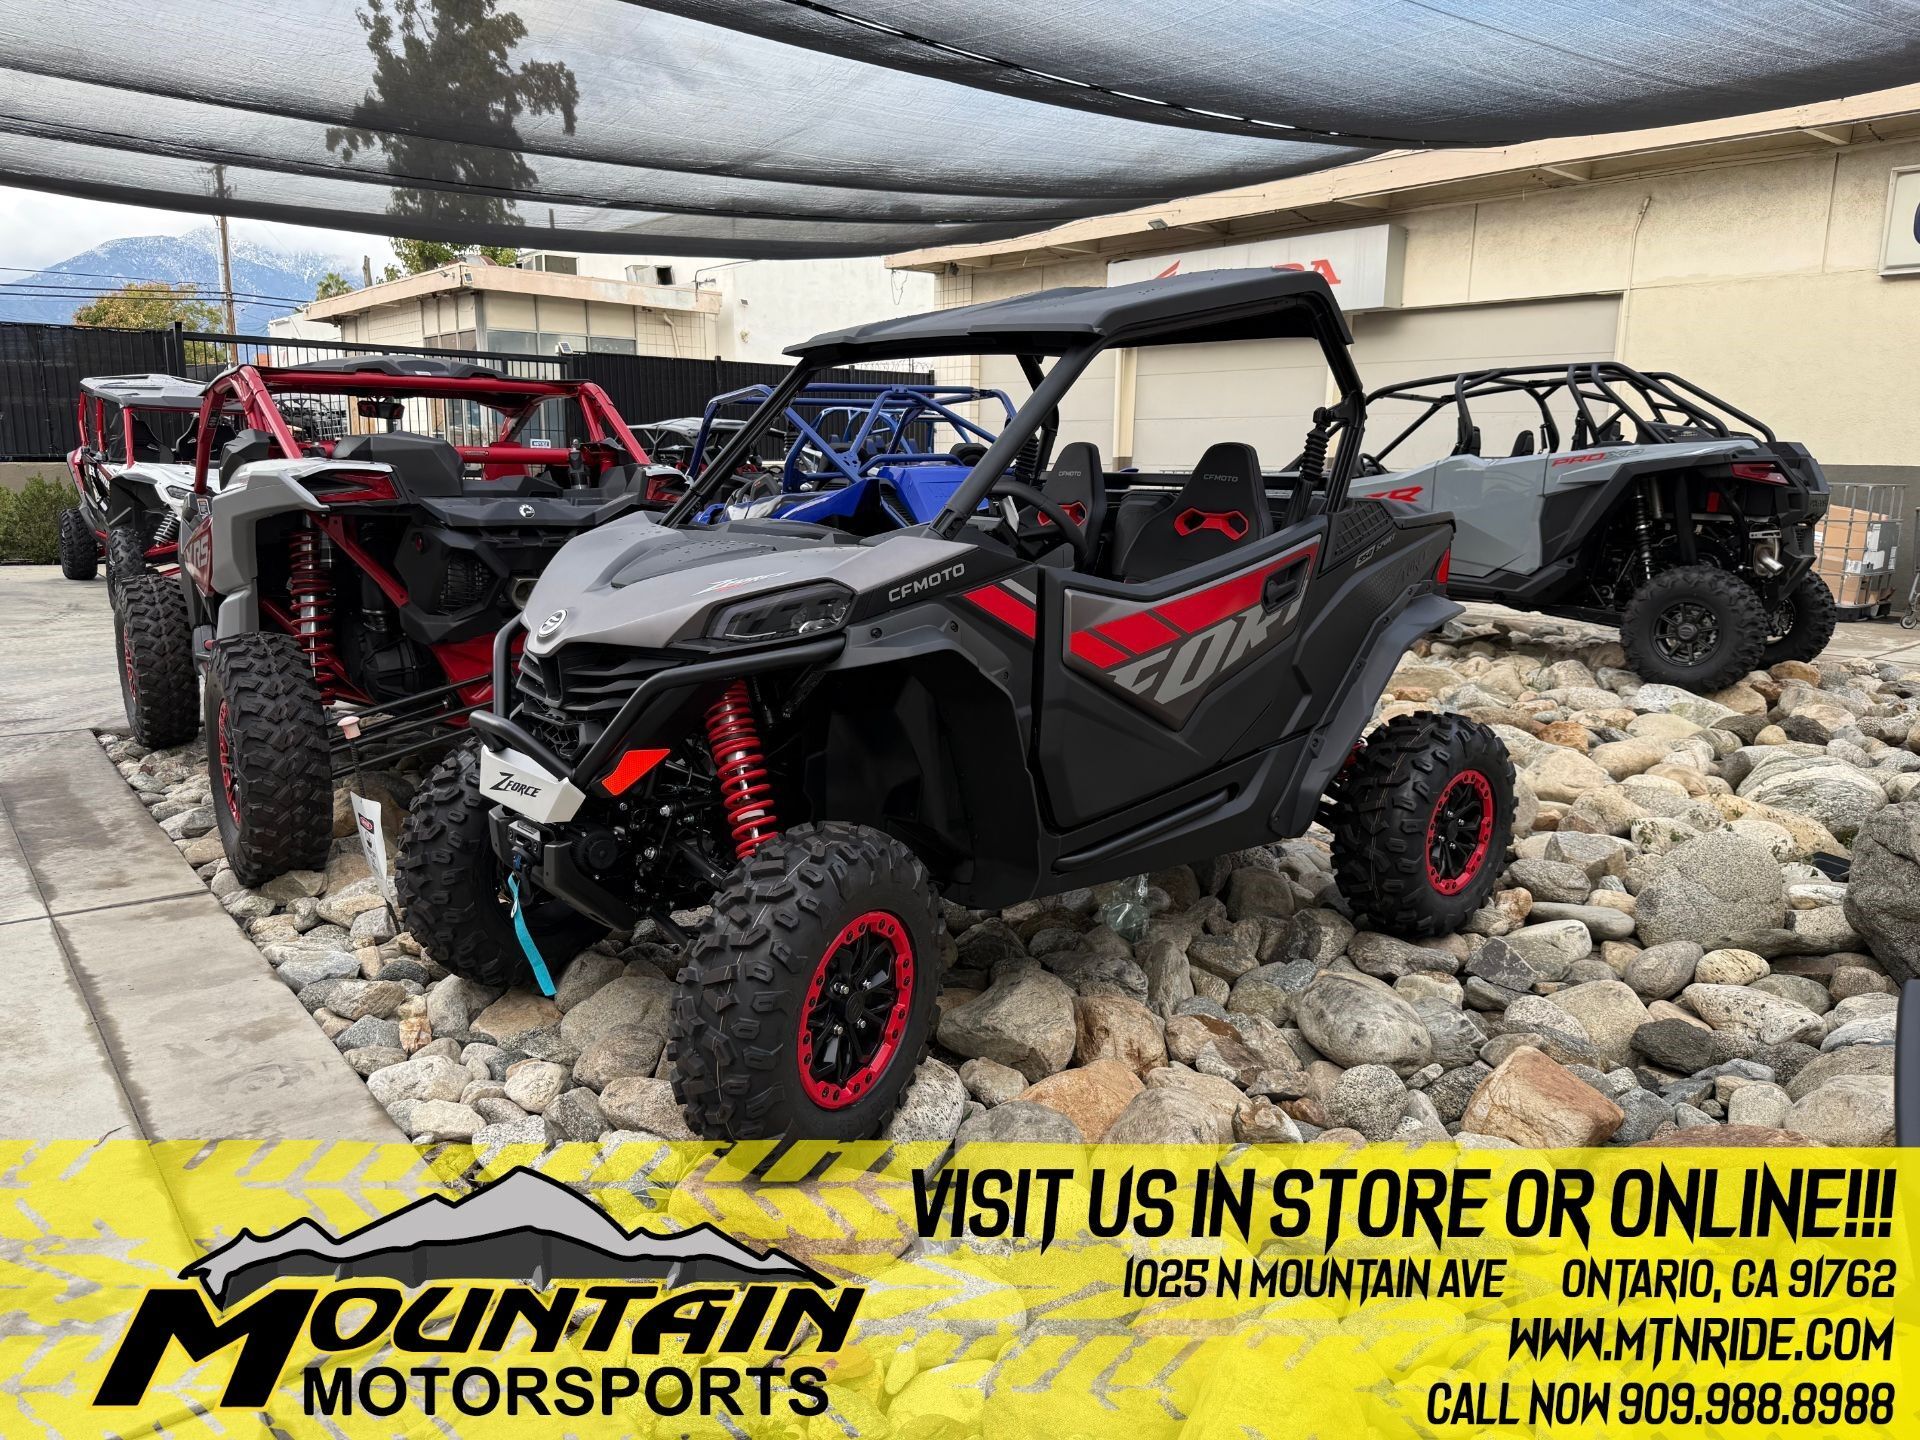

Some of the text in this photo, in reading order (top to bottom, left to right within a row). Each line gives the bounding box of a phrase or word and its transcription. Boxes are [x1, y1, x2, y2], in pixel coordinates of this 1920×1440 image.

[1203, 473, 1239, 483] CFMOTO
[887, 562, 966, 603] CFMOTO
[489, 771, 543, 798] ZFORCE
